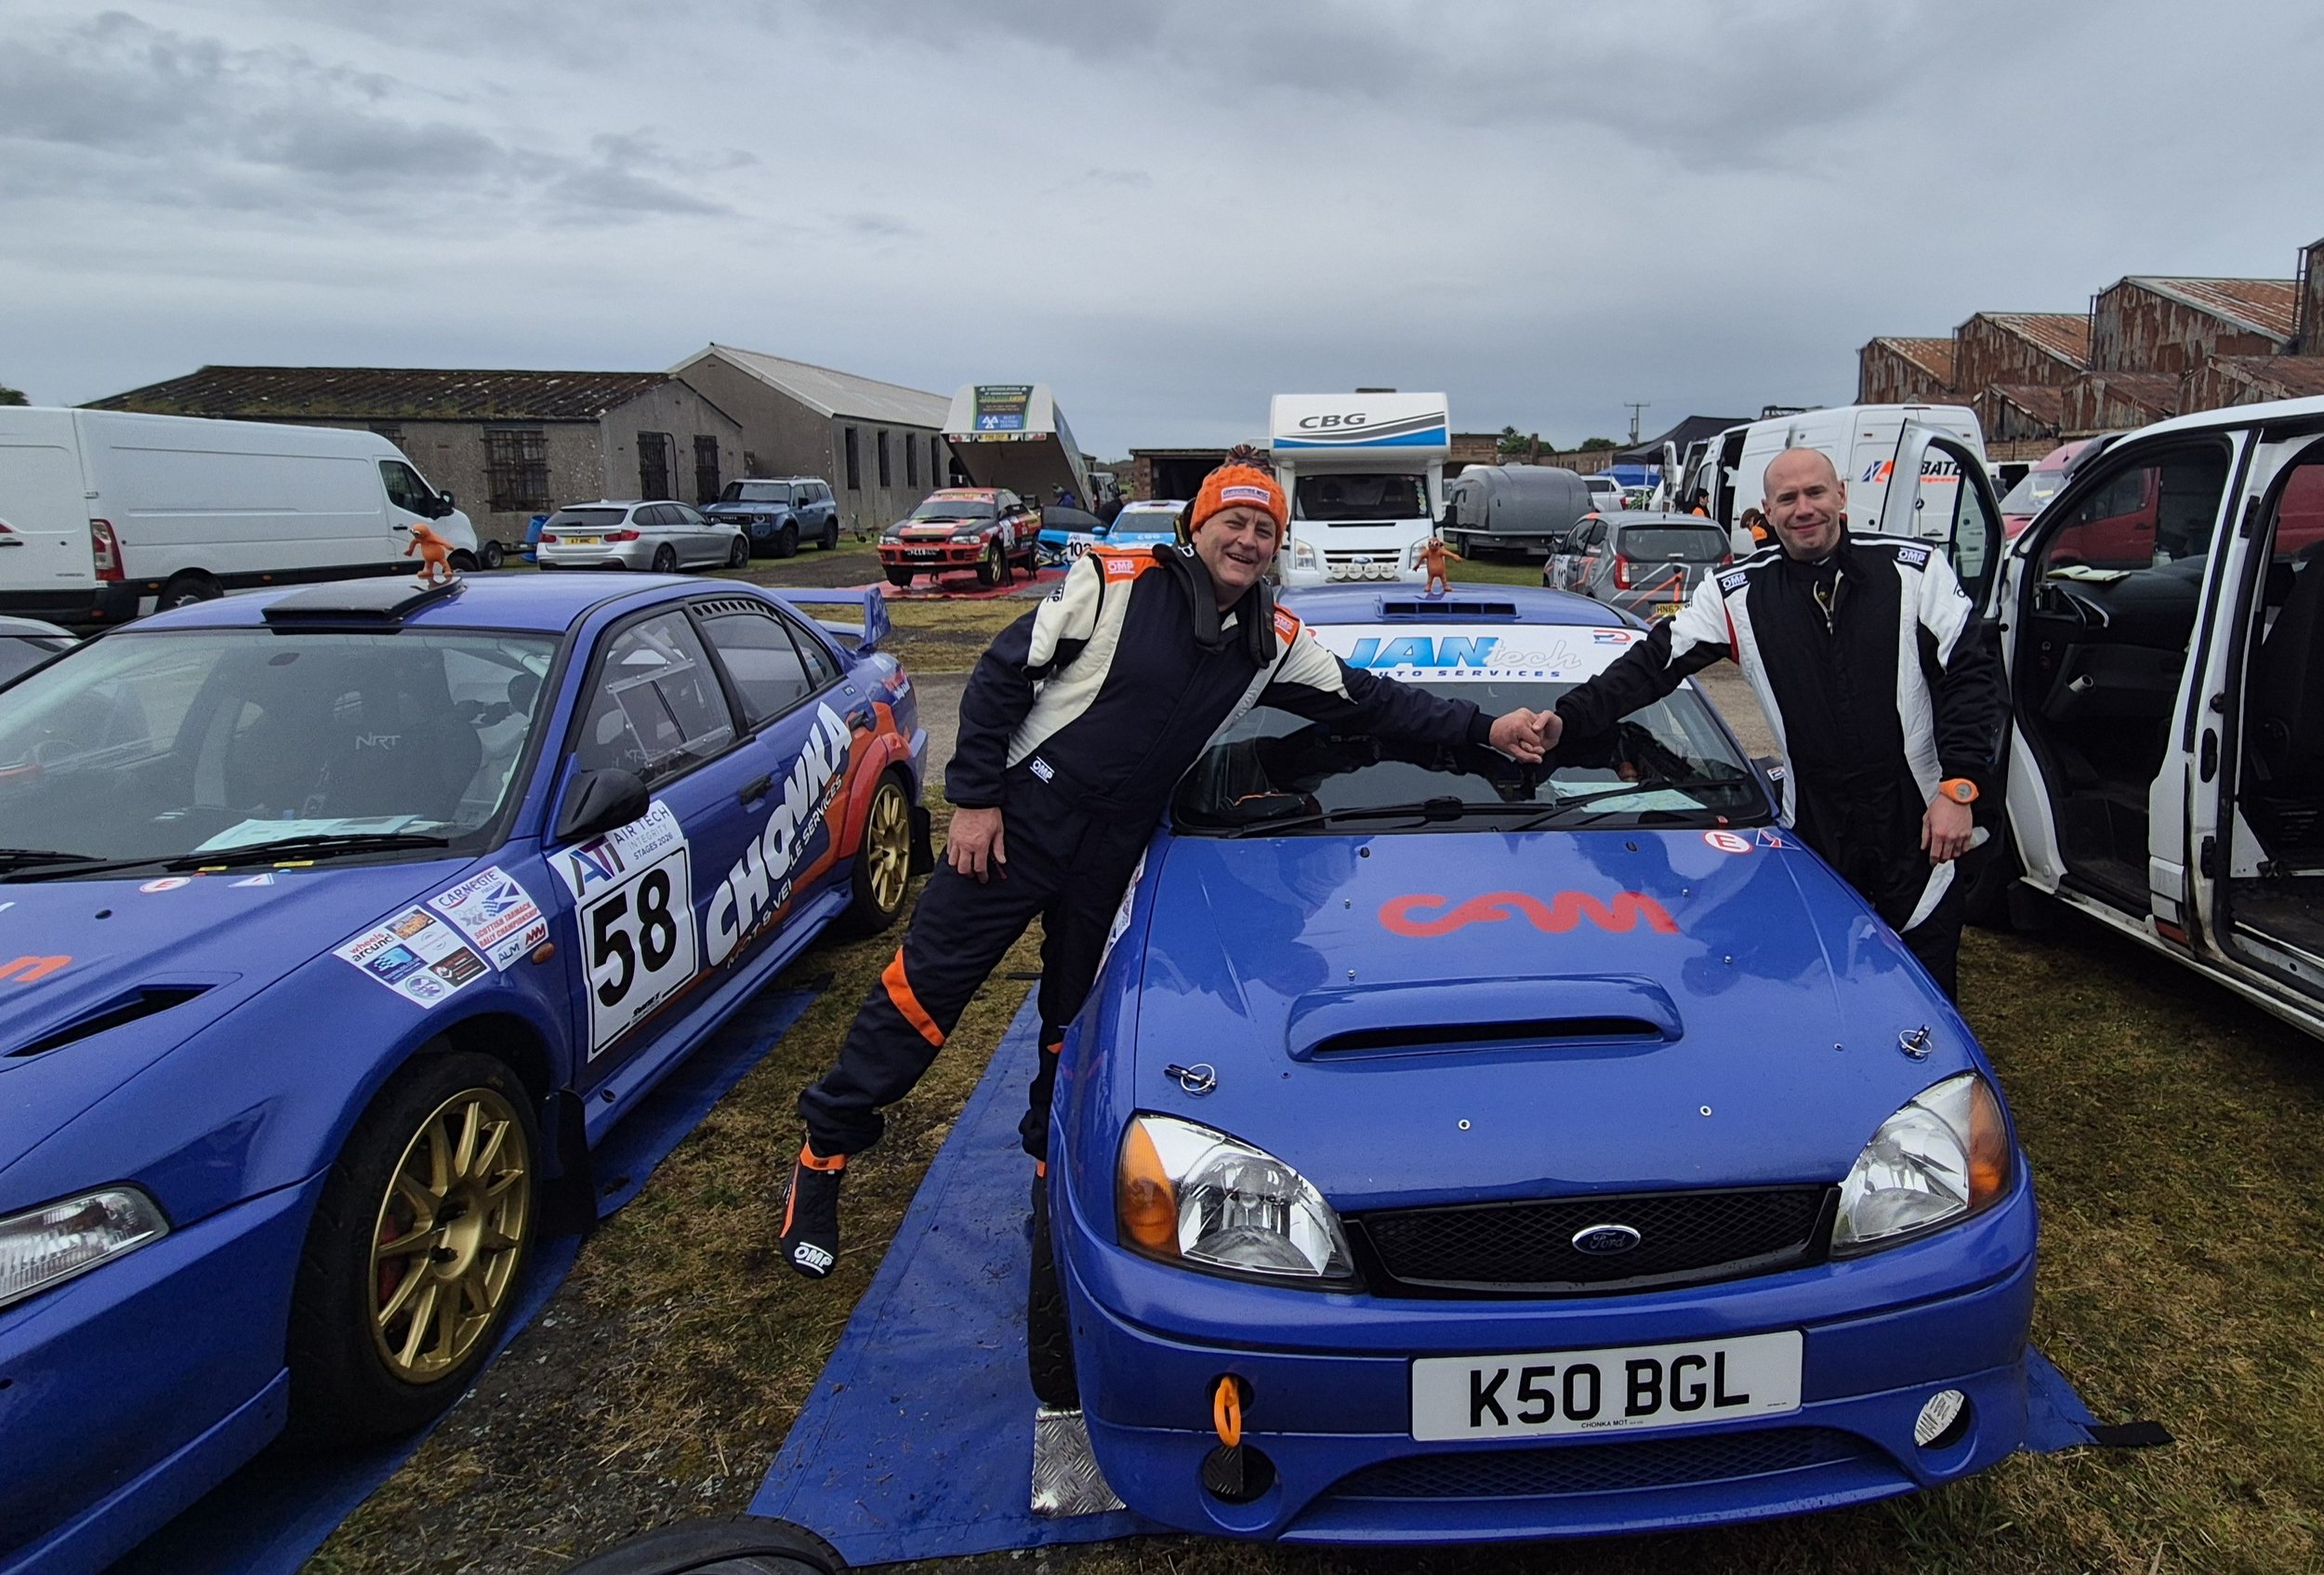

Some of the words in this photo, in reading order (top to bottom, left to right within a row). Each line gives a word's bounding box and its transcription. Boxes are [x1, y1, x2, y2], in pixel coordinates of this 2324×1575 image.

[1299, 413, 1367, 430] CBG
[1107, 561, 1134, 572] OMP
[1898, 550, 1926, 563] OMP
[1723, 573, 1747, 588] OMP
[1378, 669, 1422, 678] UTO
[1437, 669, 1561, 678] SERVICES
[1032, 760, 1053, 780] OMP
[802, 774, 842, 846] SERVICES
[613, 826, 638, 845] AIR
[637, 806, 670, 830] TECH
[628, 823, 668, 851] INTEGRITY
[706, 701, 852, 967] CHONKA
[633, 841, 658, 861] STAGES
[1713, 833, 1741, 850] E
[439, 870, 499, 907] CARNEGIE
[474, 917, 505, 939] SCOTTISH
[504, 901, 532, 921] TARMACK
[479, 934, 496, 948] RALLY
[496, 907, 538, 937] CHAMPIONSHIP
[349, 931, 386, 955] wheels
[351, 933, 395, 963] around
[592, 868, 677, 1008] 58
[1590, 1232, 1626, 1249] Ford
[794, 1245, 833, 1268] OMP
[1470, 1362, 1602, 1428] K50
[1624, 1351, 1750, 1418] BGL
[1581, 1421, 1611, 1429] CHONKA
